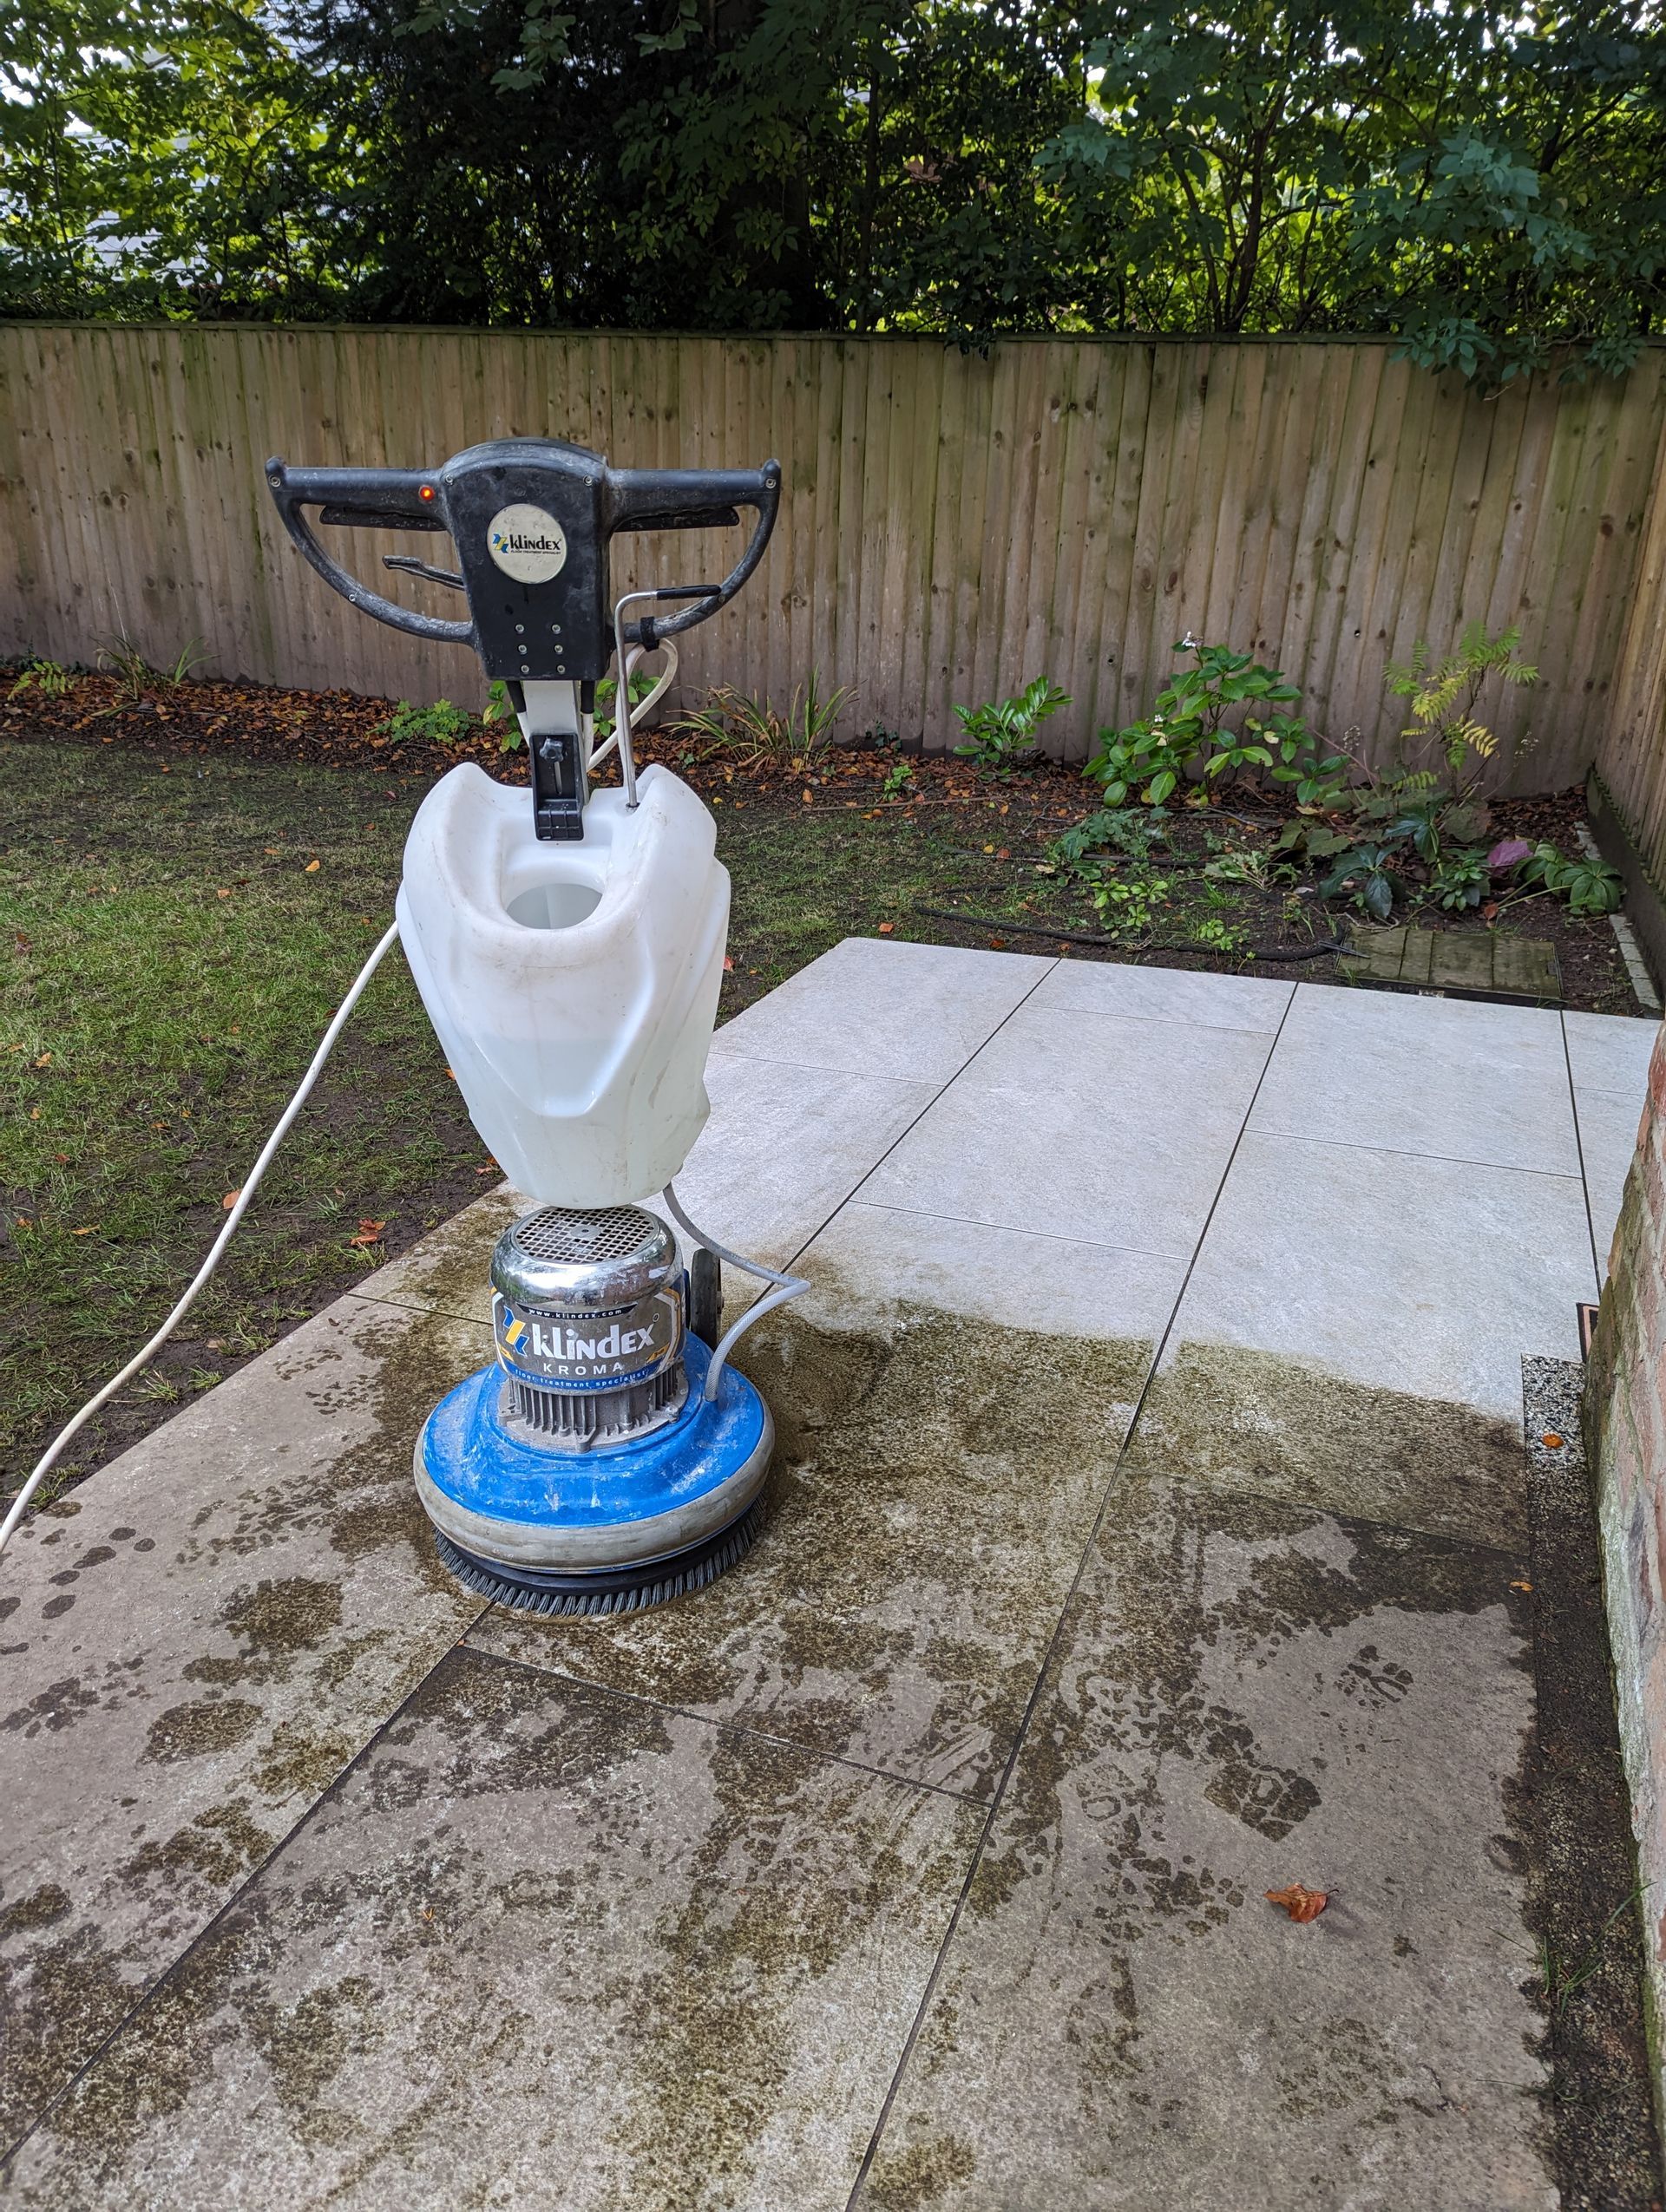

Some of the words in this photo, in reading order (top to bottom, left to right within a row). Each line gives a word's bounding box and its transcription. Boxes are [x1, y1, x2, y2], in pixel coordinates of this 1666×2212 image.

[528, 1308, 622, 1319] www.klindex.com
[543, 1362, 624, 1376] KROMA
[515, 1369, 535, 1381] floor
[540, 1378, 589, 1387] treatment
[595, 1370, 646, 1387] specialist
